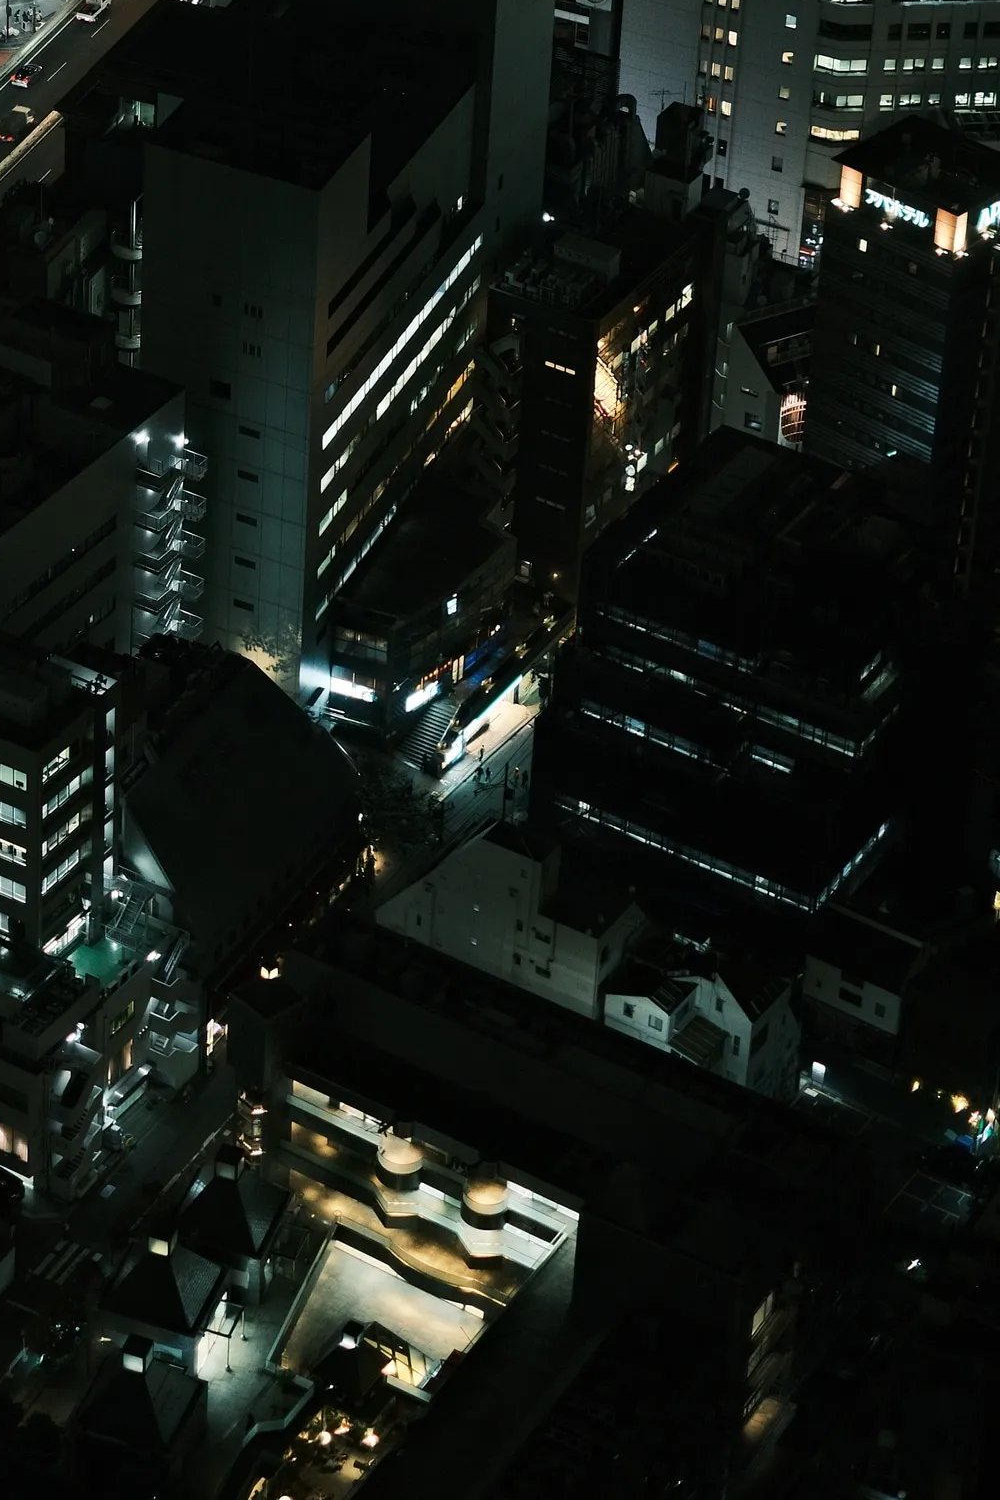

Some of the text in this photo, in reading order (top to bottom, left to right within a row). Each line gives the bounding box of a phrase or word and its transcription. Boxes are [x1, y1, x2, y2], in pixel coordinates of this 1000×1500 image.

[865, 188, 930, 228] アパホテル
